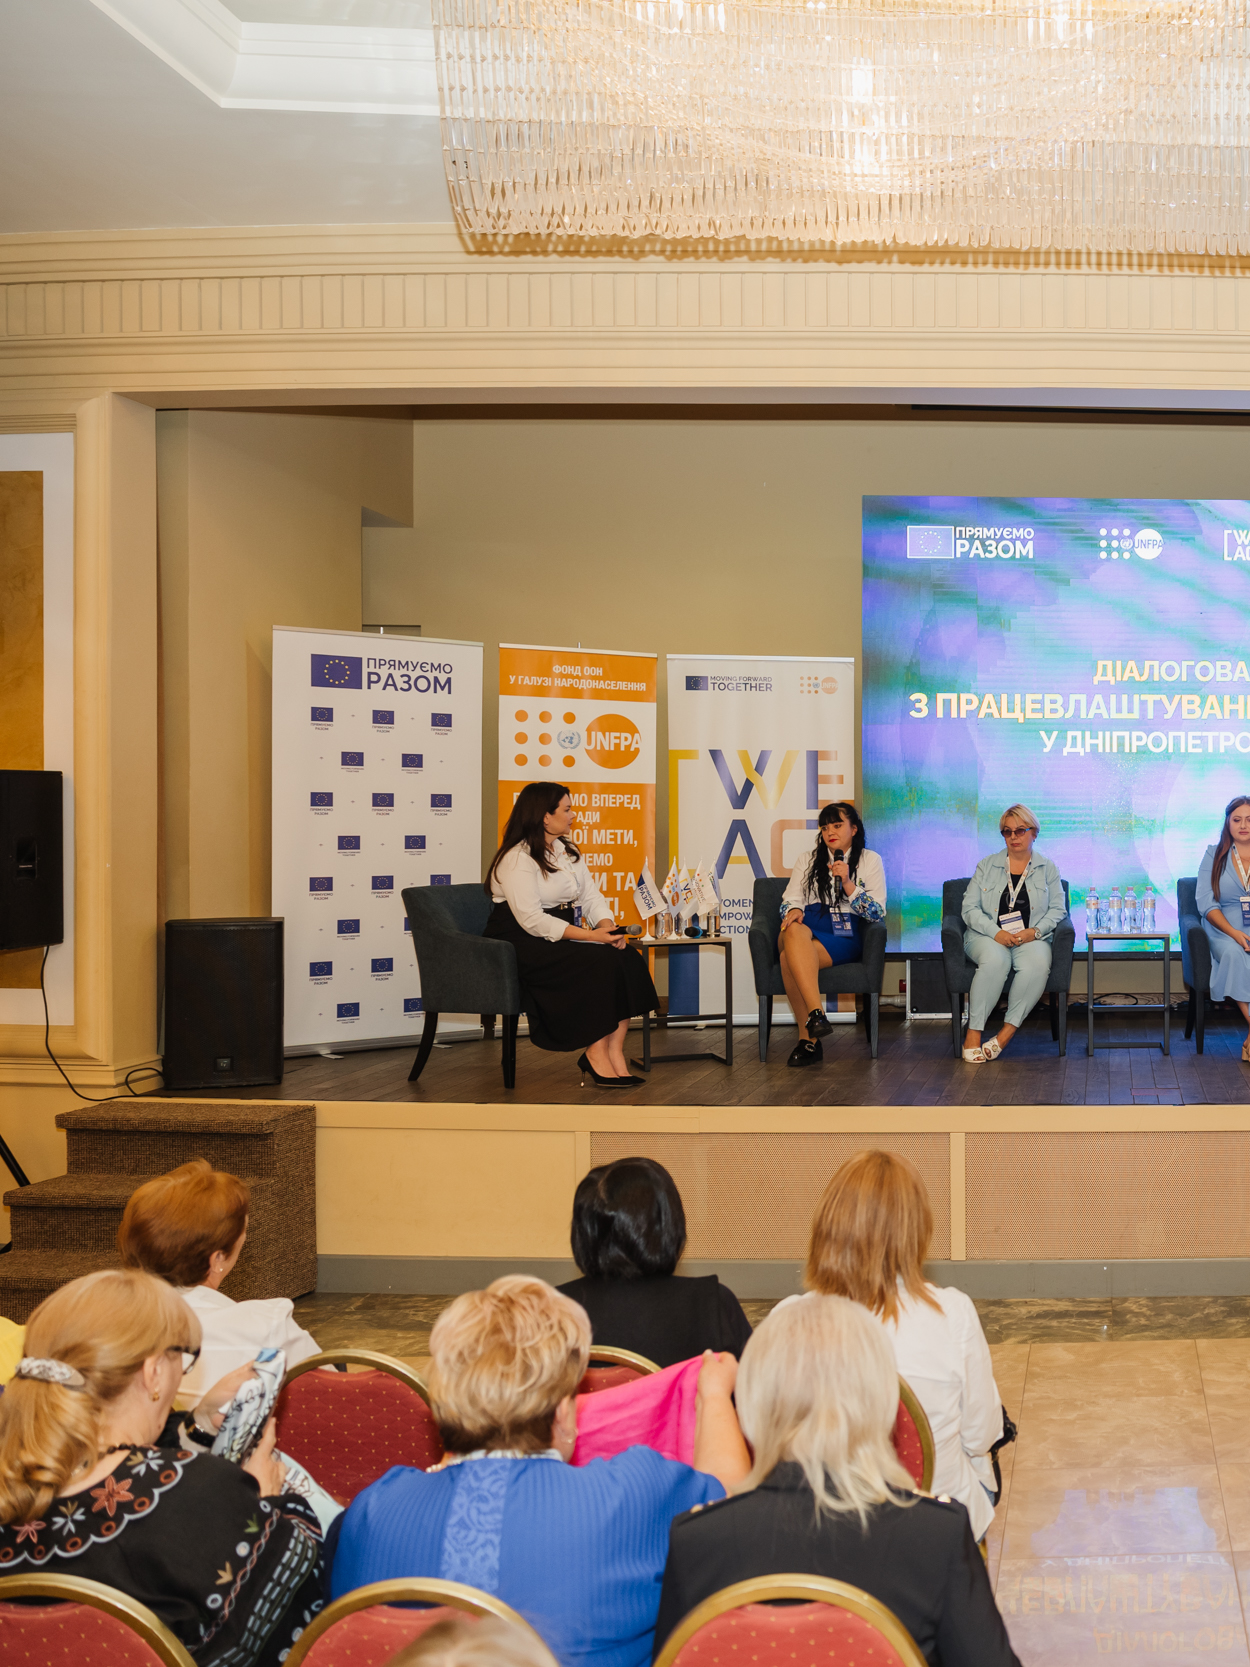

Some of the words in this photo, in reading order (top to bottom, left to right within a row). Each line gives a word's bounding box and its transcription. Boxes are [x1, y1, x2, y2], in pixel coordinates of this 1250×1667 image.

[955, 527, 1034, 539] ПРЯМУЄМО
[956, 540, 1034, 558] РАЗОМ
[1134, 538, 1163, 549] UNFPA
[367, 658, 453, 674] ПРЯМУЄМО
[553, 665, 581, 676] ФОНД
[584, 666, 603, 676] ООН
[1093, 660, 1250, 685] ДІАЛОГОВА
[367, 671, 452, 694] РАЗОМ
[509, 675, 516, 684] У
[518, 676, 552, 686] ГАЛУЗІ
[554, 678, 646, 691] НАРОДОНАСЕЛЕННЯ
[710, 682, 773, 692] TOGETHER
[909, 693, 929, 719] З
[584, 731, 642, 751] UNFPA
[1039, 731, 1059, 753] У
[708, 749, 854, 810] WE
[592, 794, 641, 810] ВПЕРЕД
[593, 829, 638, 847] МЕТИ,
[716, 819, 820, 879] AC
[613, 872, 636, 891] ТА
[721, 899, 753, 907] OMEN
